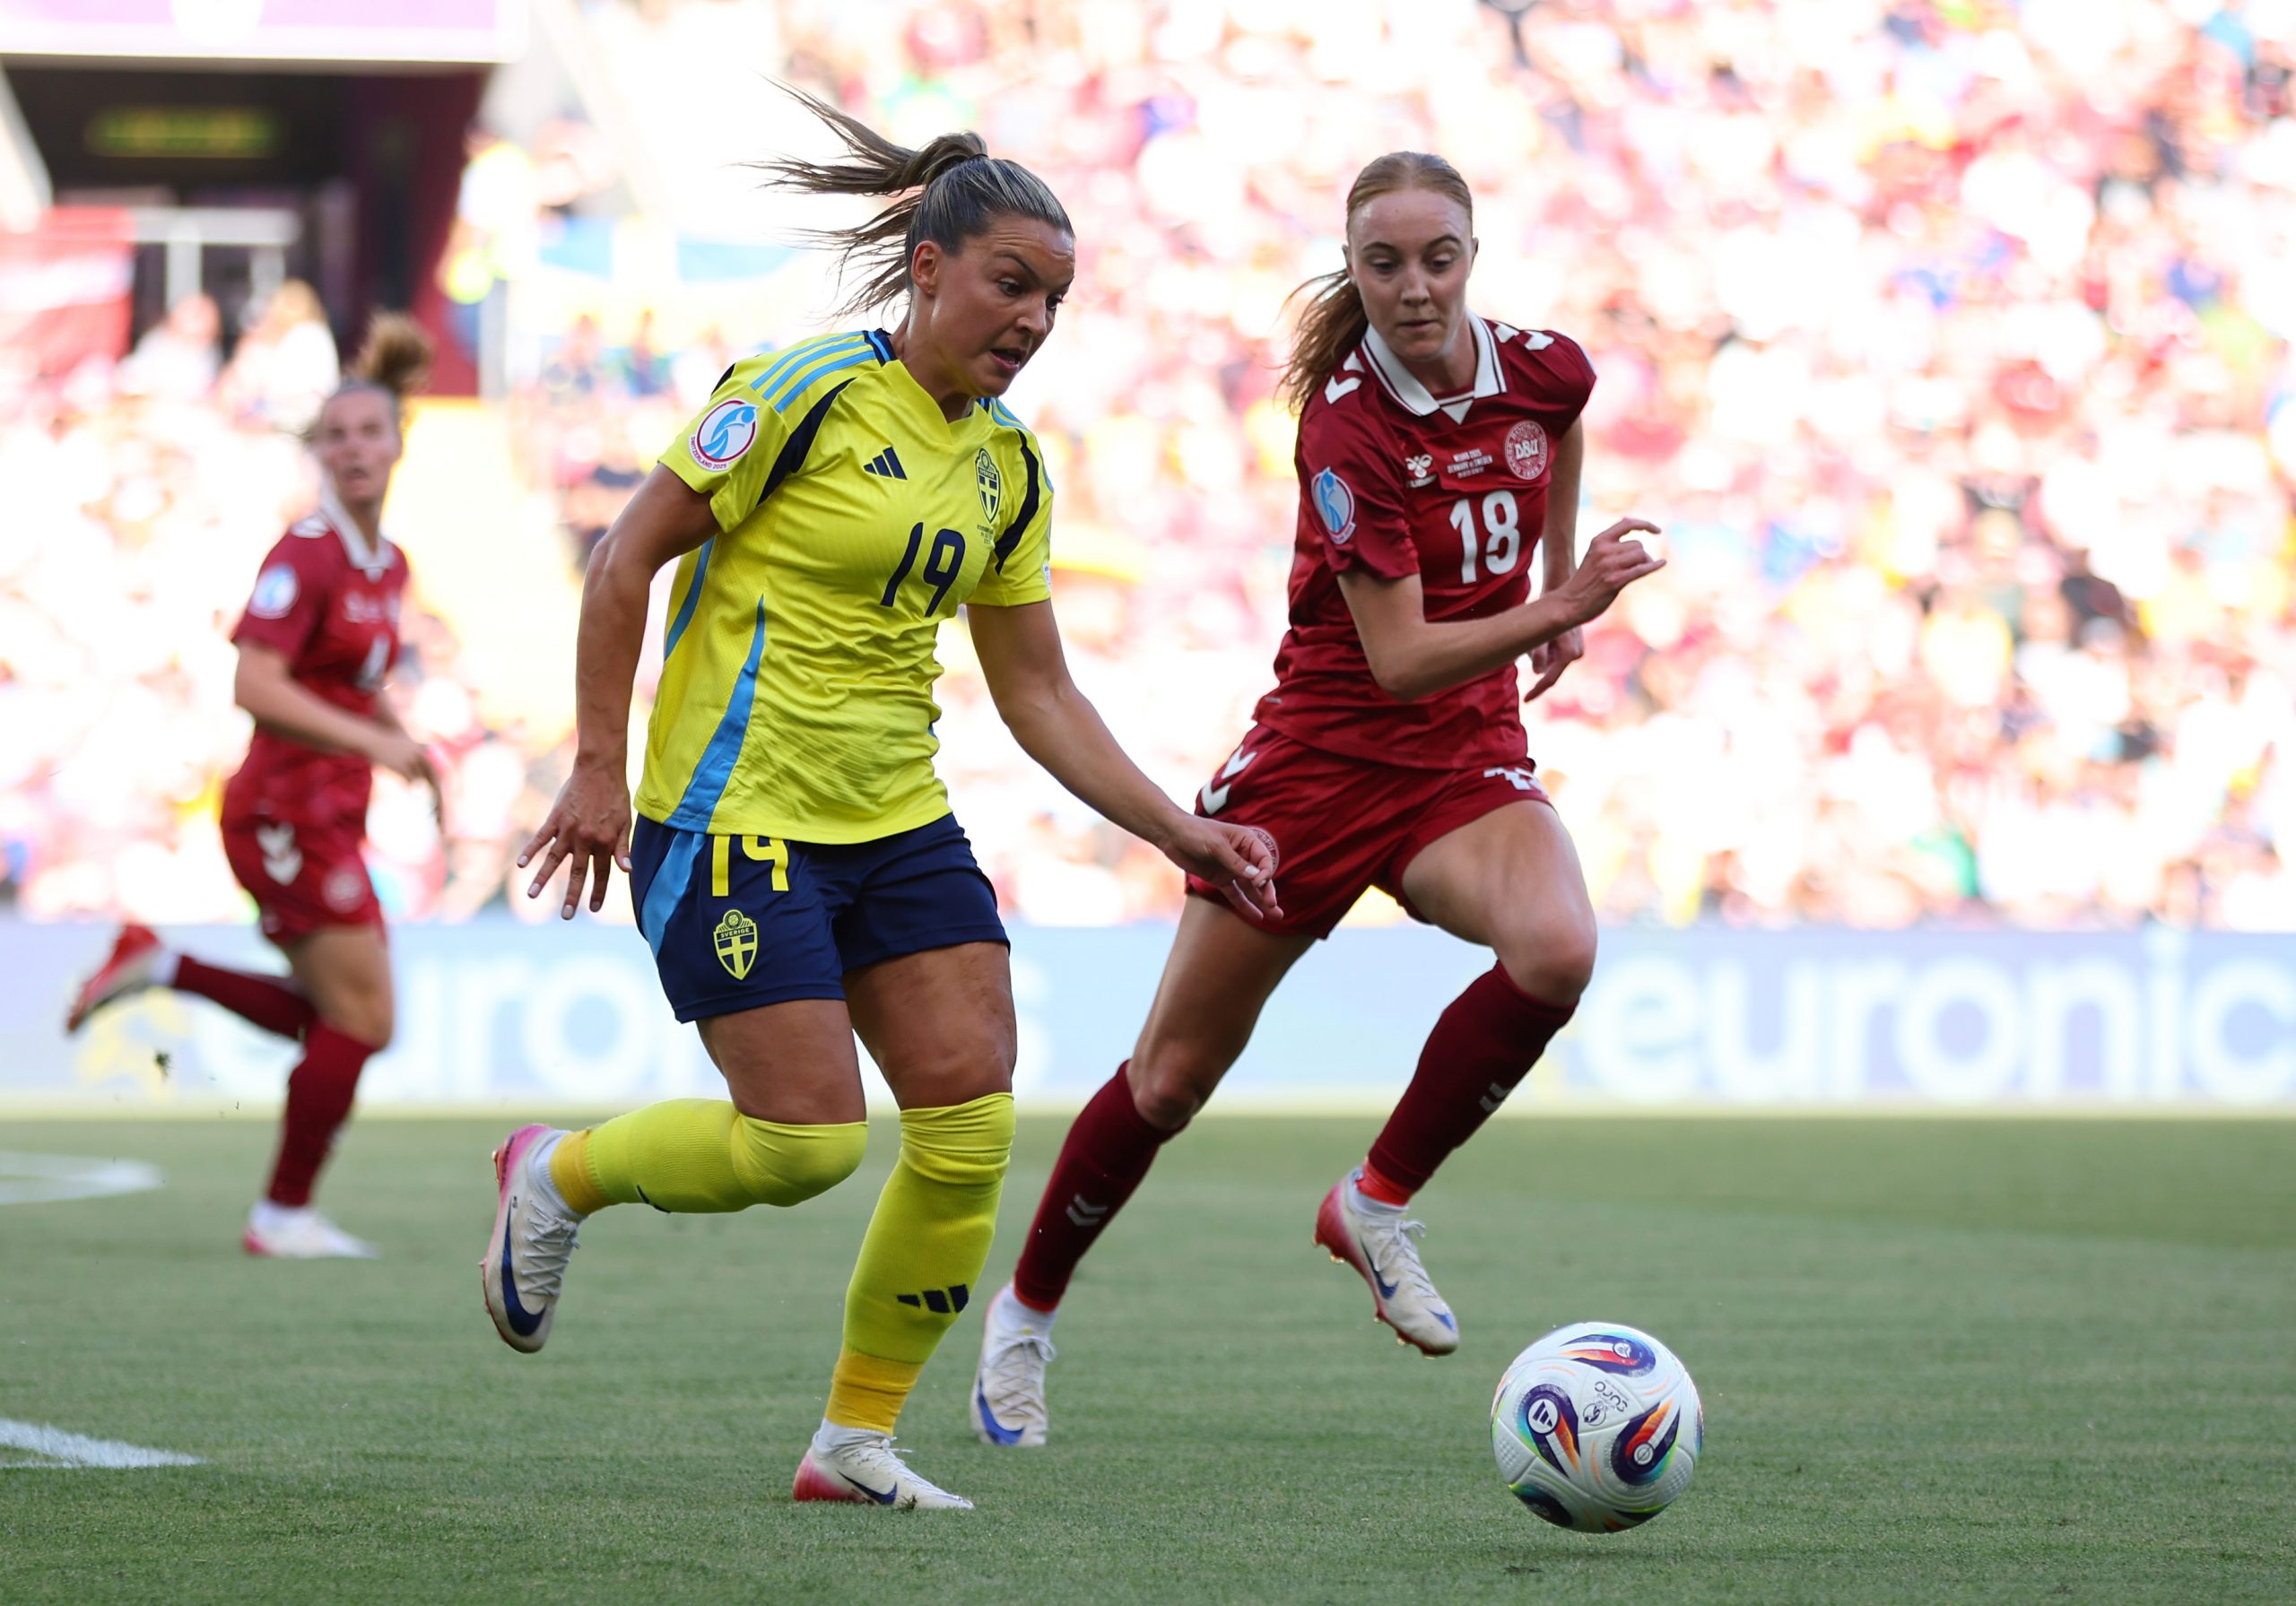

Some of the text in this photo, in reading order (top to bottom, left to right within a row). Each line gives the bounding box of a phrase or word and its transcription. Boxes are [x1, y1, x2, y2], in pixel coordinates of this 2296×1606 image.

[1514, 438, 1539, 460] DBU
[1449, 490, 1520, 584] 18
[880, 522, 966, 617] 19
[712, 834, 789, 897] 19
[720, 927, 750, 938] SVERIGE
